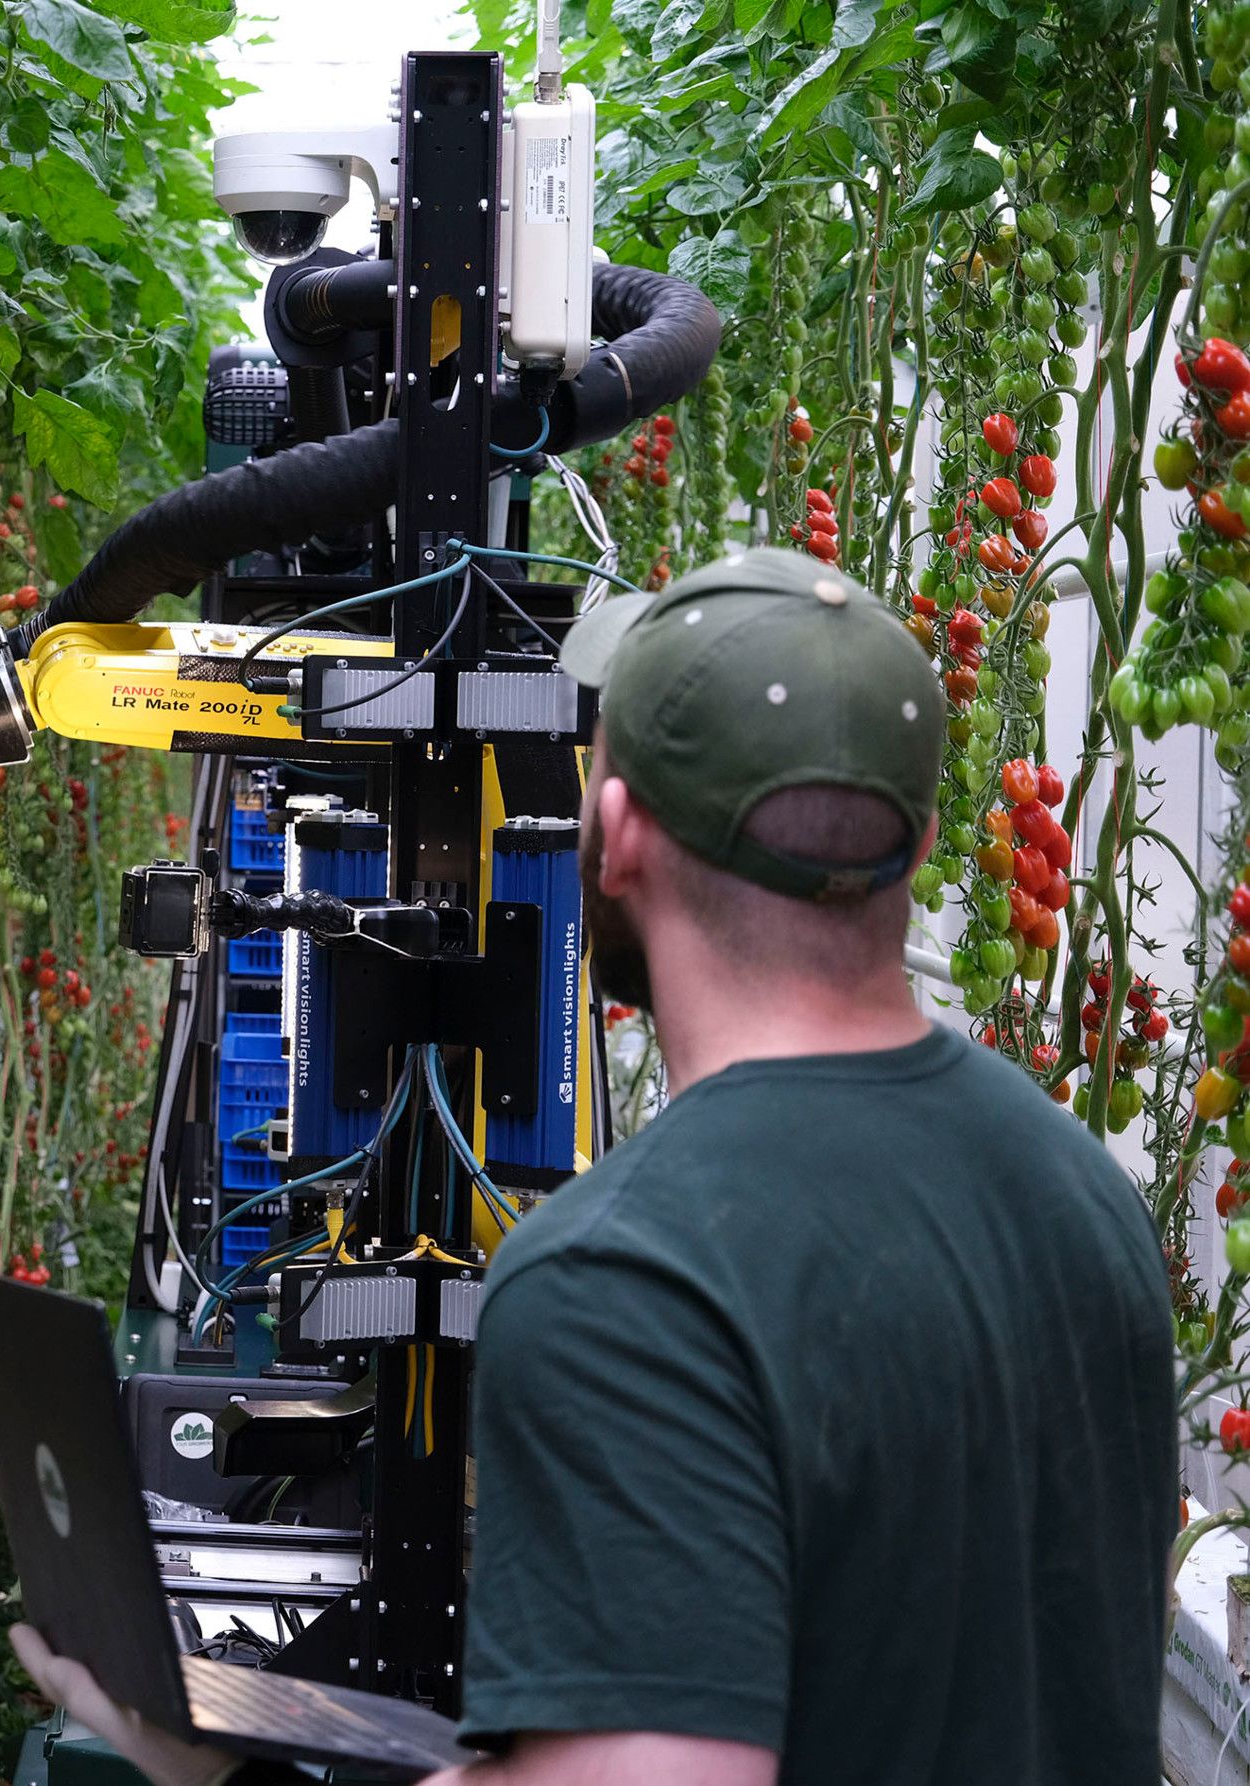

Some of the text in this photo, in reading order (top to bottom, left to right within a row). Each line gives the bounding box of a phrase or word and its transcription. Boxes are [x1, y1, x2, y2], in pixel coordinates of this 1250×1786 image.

[113, 685, 196, 699] FANUC Robot
[112, 697, 263, 716] LR Mate 200iD
[241, 715, 261, 726] 7L
[301, 930, 312, 981] smart
[563, 1029, 573, 1080] smart
